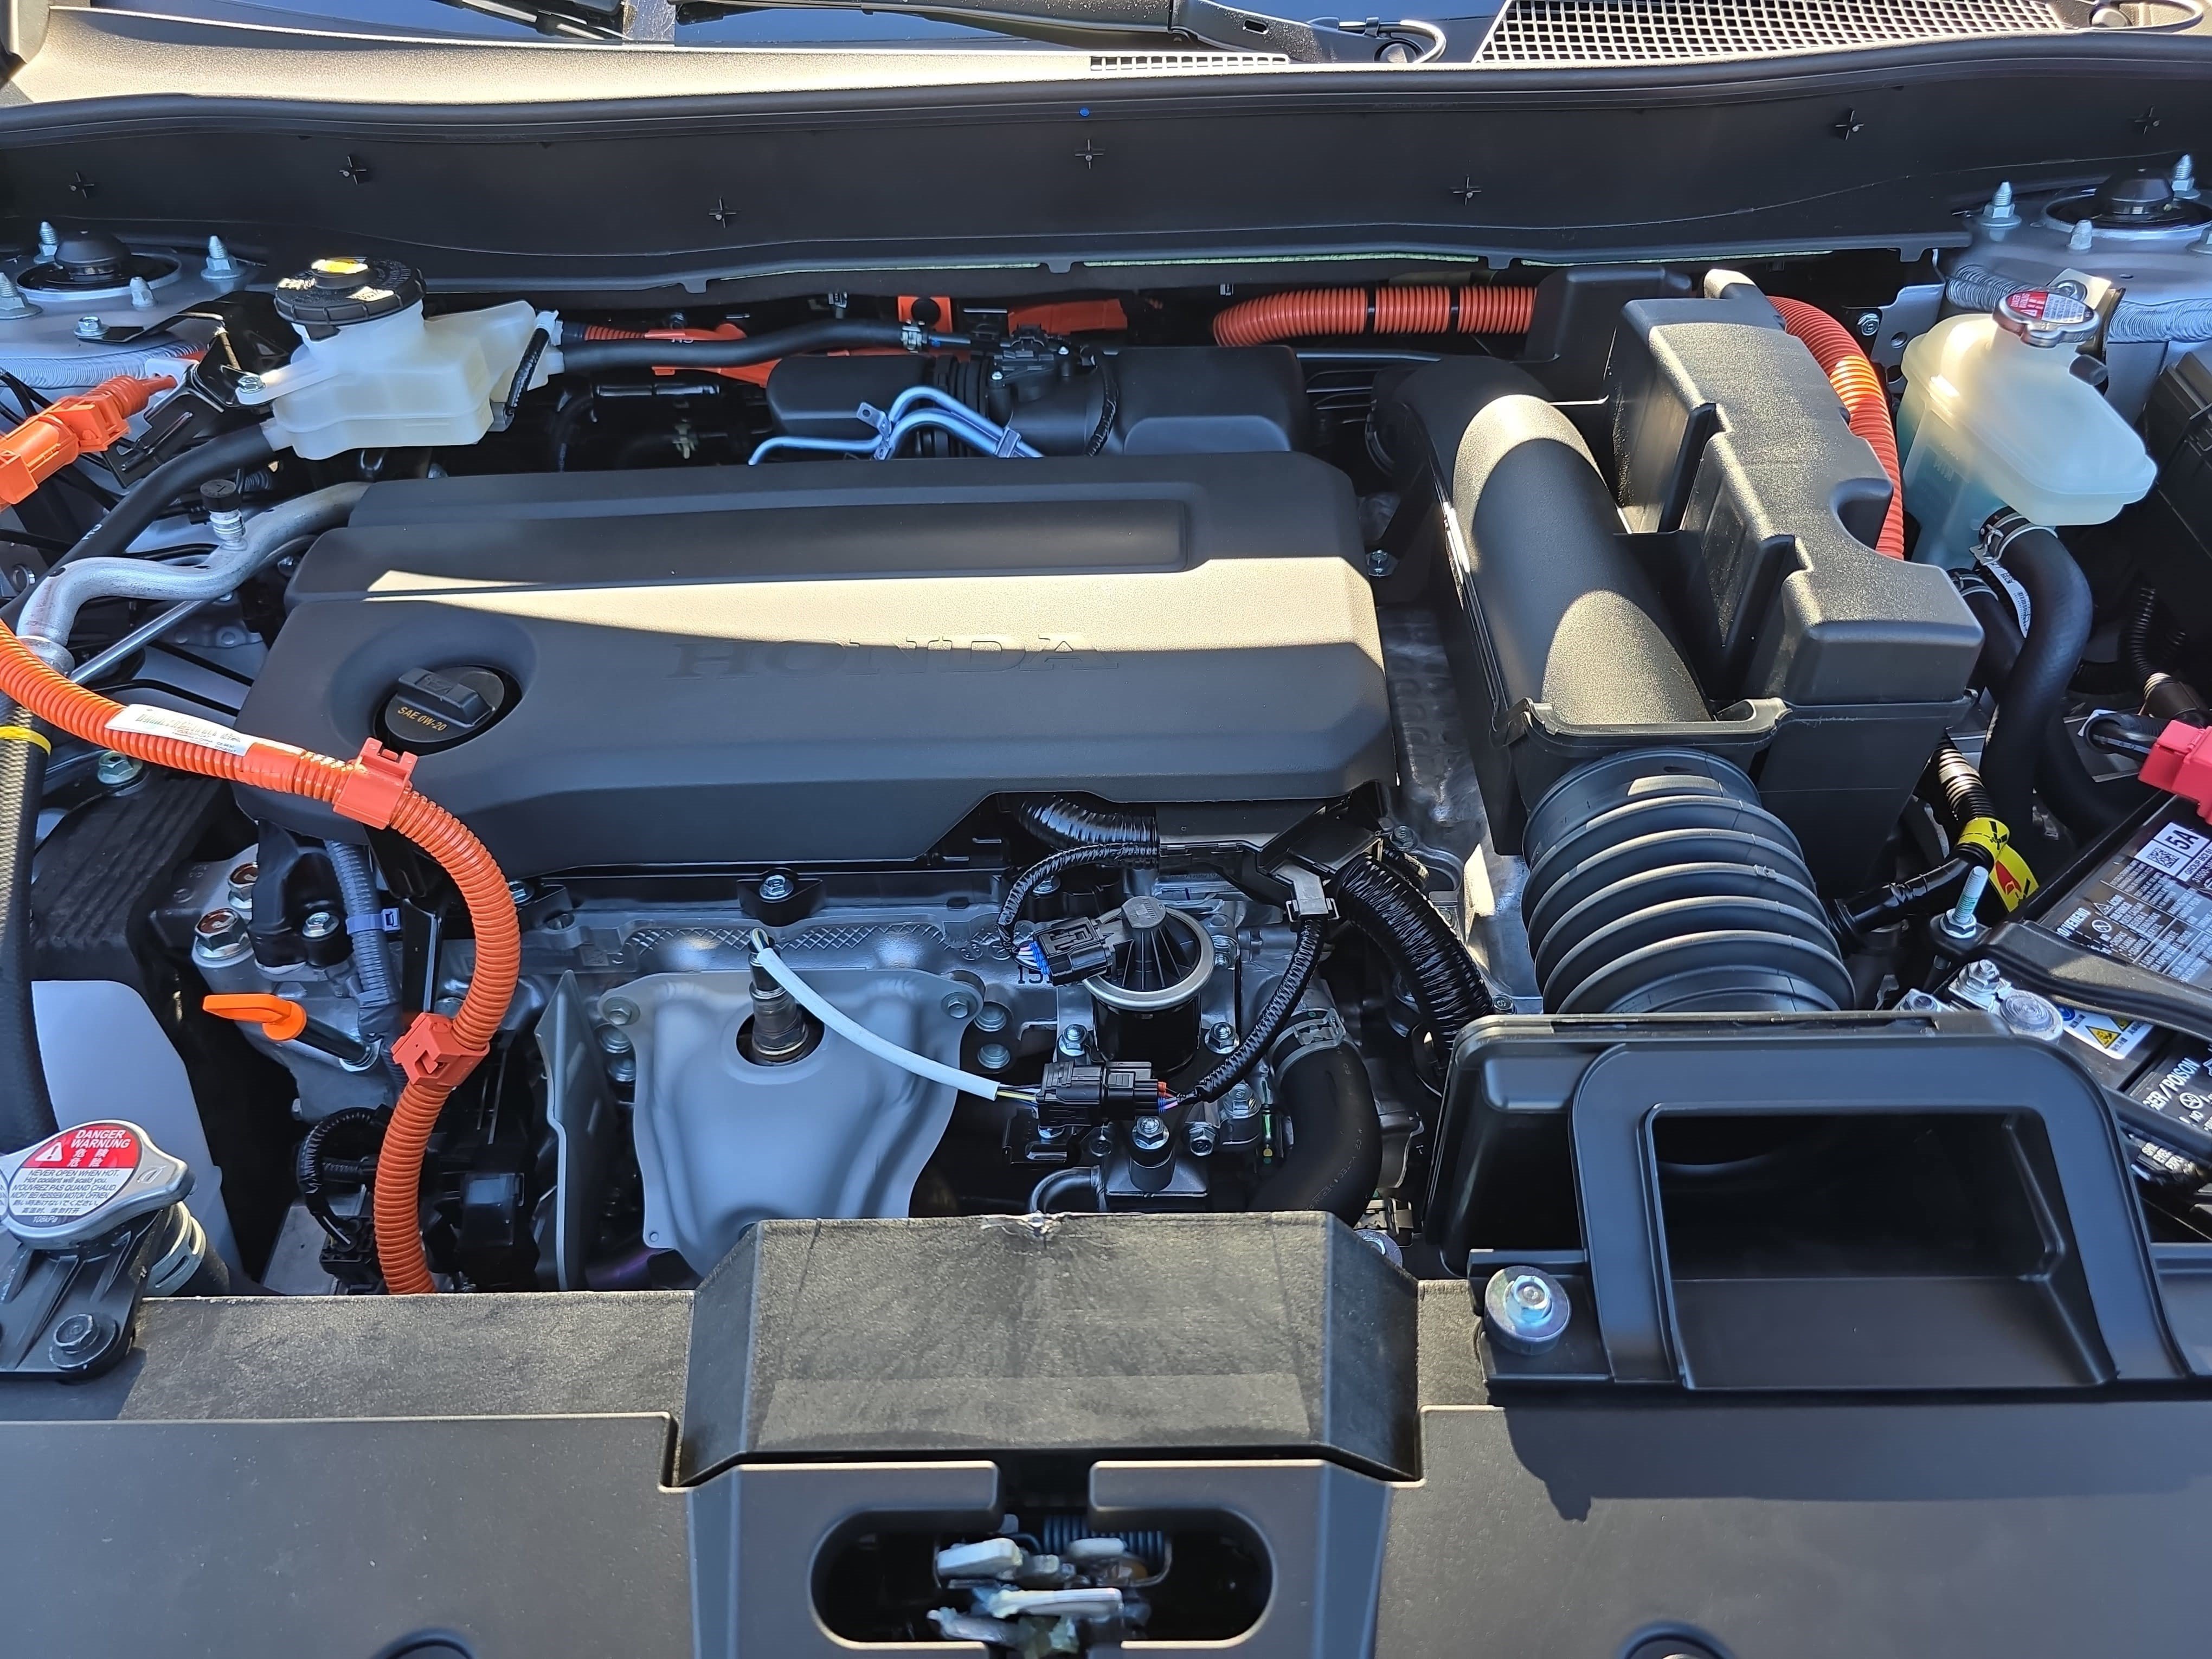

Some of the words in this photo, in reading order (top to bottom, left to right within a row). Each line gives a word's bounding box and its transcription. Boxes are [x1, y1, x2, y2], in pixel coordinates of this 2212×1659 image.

[665, 634, 1118, 680] HONDA
[397, 706, 422, 719] SAE
[417, 715, 447, 732] 0W-20
[2164, 829, 2200, 850] 5A
[2185, 859, 2201, 874] GROUP
[2198, 853, 2209, 861] BCI
[1018, 965, 1052, 984] 15
[70, 1139, 131, 1148] WARNUNG
[75, 1130, 126, 1139] DANGER
